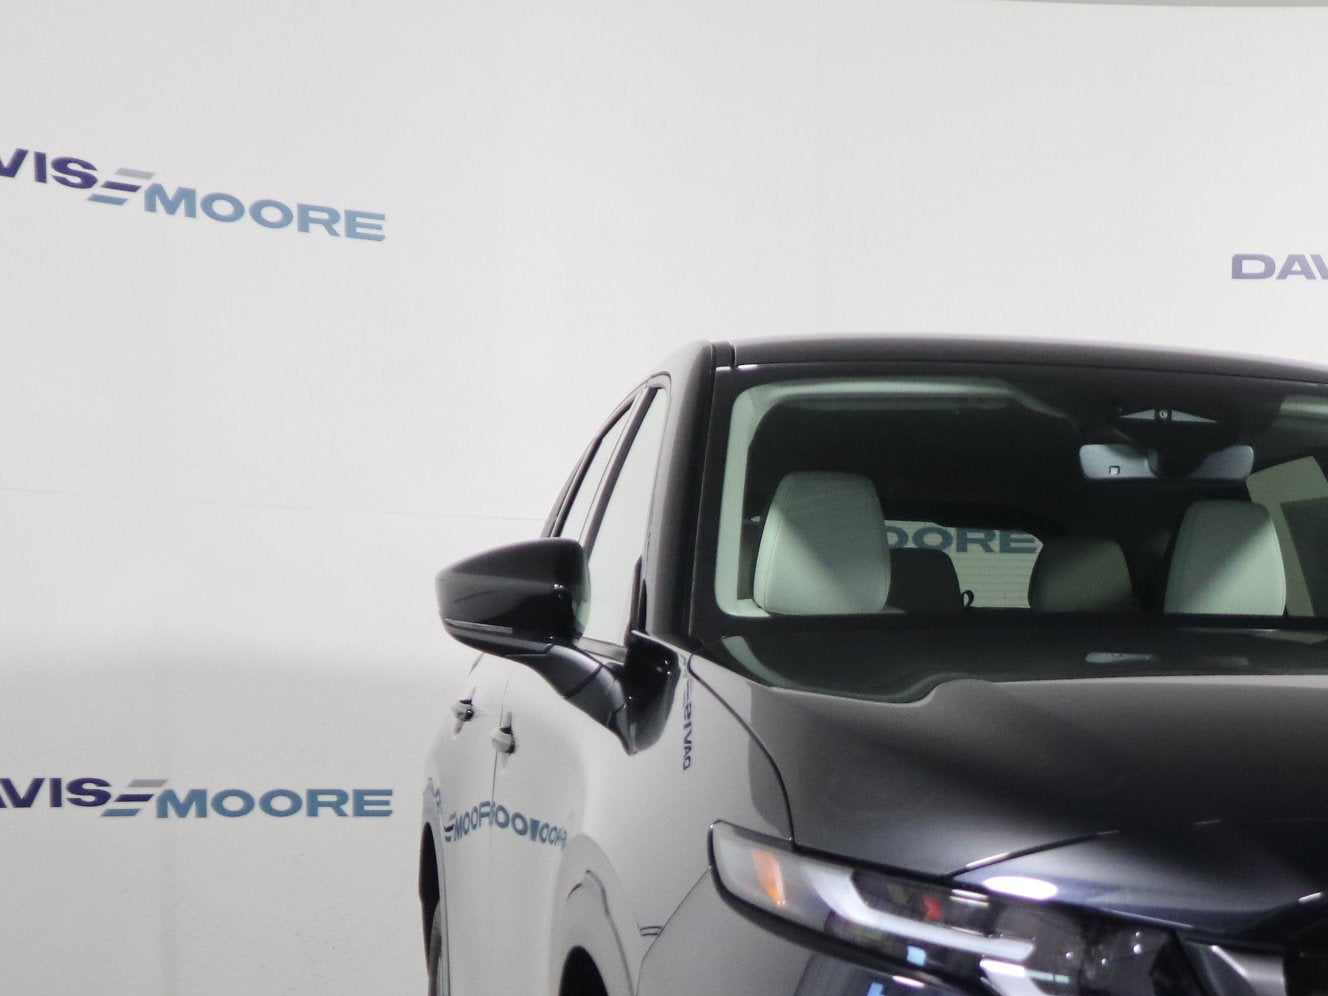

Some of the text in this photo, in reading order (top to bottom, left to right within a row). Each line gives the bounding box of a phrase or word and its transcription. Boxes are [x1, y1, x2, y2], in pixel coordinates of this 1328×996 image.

[143, 182, 386, 242] MOORE
[0, 776, 394, 819] VIS MOORE
